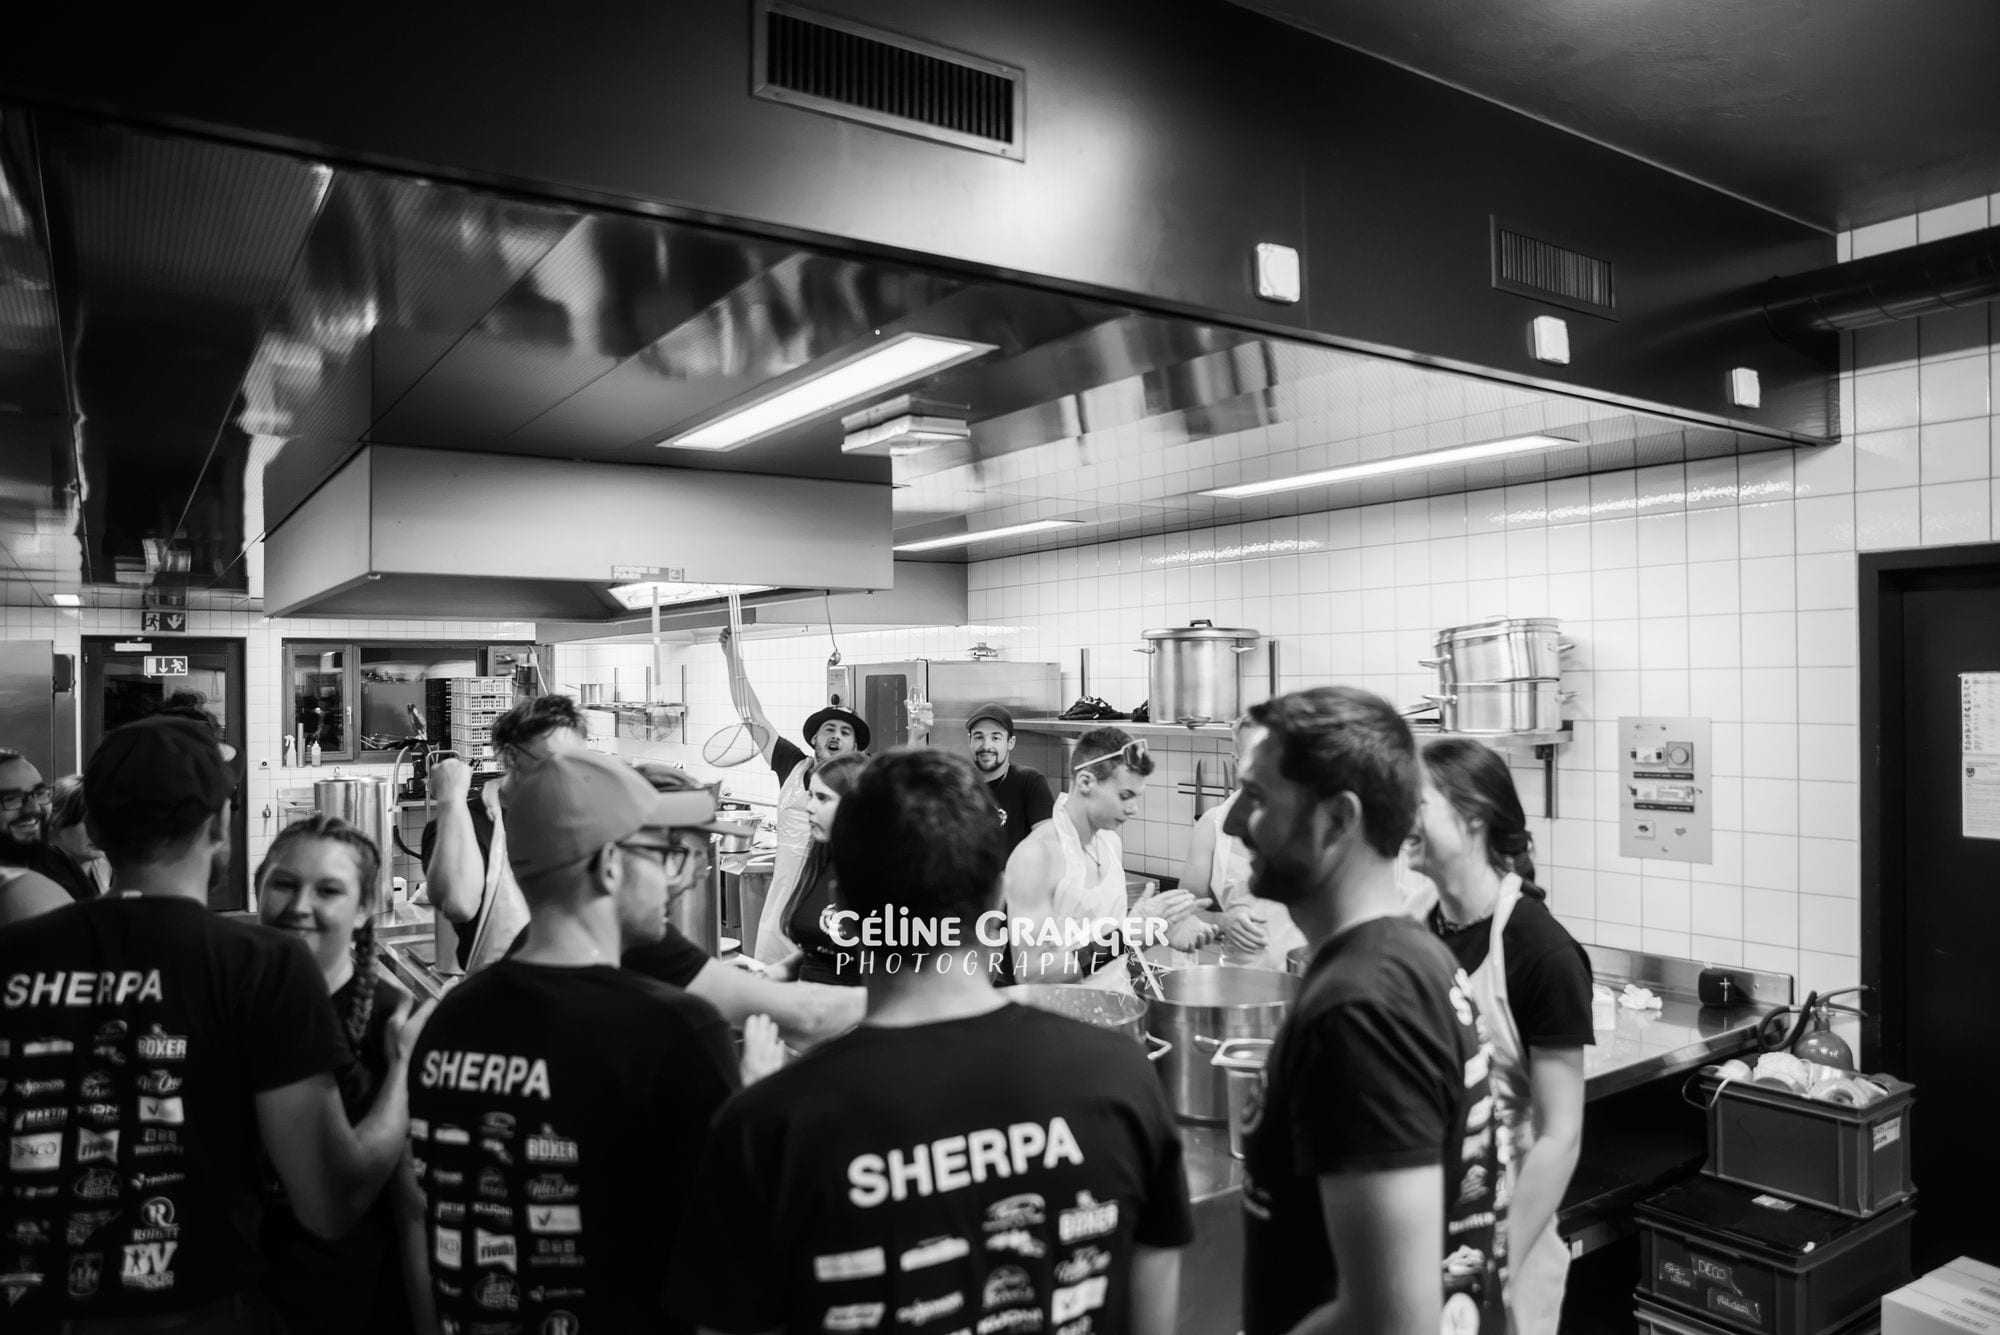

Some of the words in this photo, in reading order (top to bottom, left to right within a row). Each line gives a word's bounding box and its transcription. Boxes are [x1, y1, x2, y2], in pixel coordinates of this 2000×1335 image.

[5, 969, 163, 1006] SHERPA
[421, 1051, 551, 1099] SHERPA
[847, 1116, 1085, 1208] SHERPA
